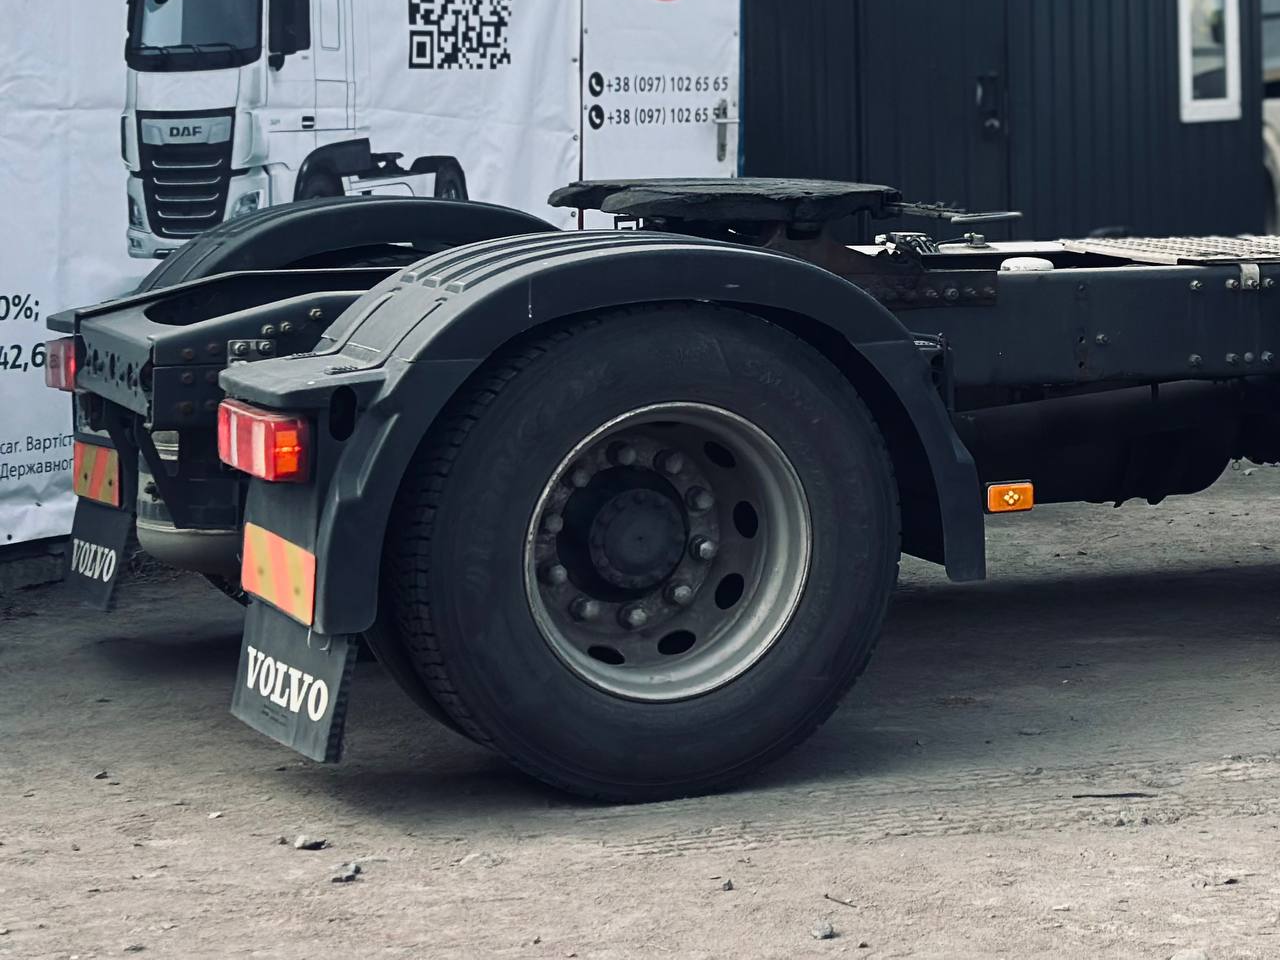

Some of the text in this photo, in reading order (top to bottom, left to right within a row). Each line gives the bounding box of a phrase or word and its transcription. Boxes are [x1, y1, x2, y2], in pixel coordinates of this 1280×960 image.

[606, 74, 729, 94] +38 (097) 102 65 65
[607, 107, 630, 125] +38
[634, 106, 667, 127] (097)
[670, 107, 692, 123] 102
[694, 107, 709, 123] 65
[169, 126, 203, 138] DAF
[71, 538, 117, 583] VOLVO
[246, 645, 329, 722] VOLVO
